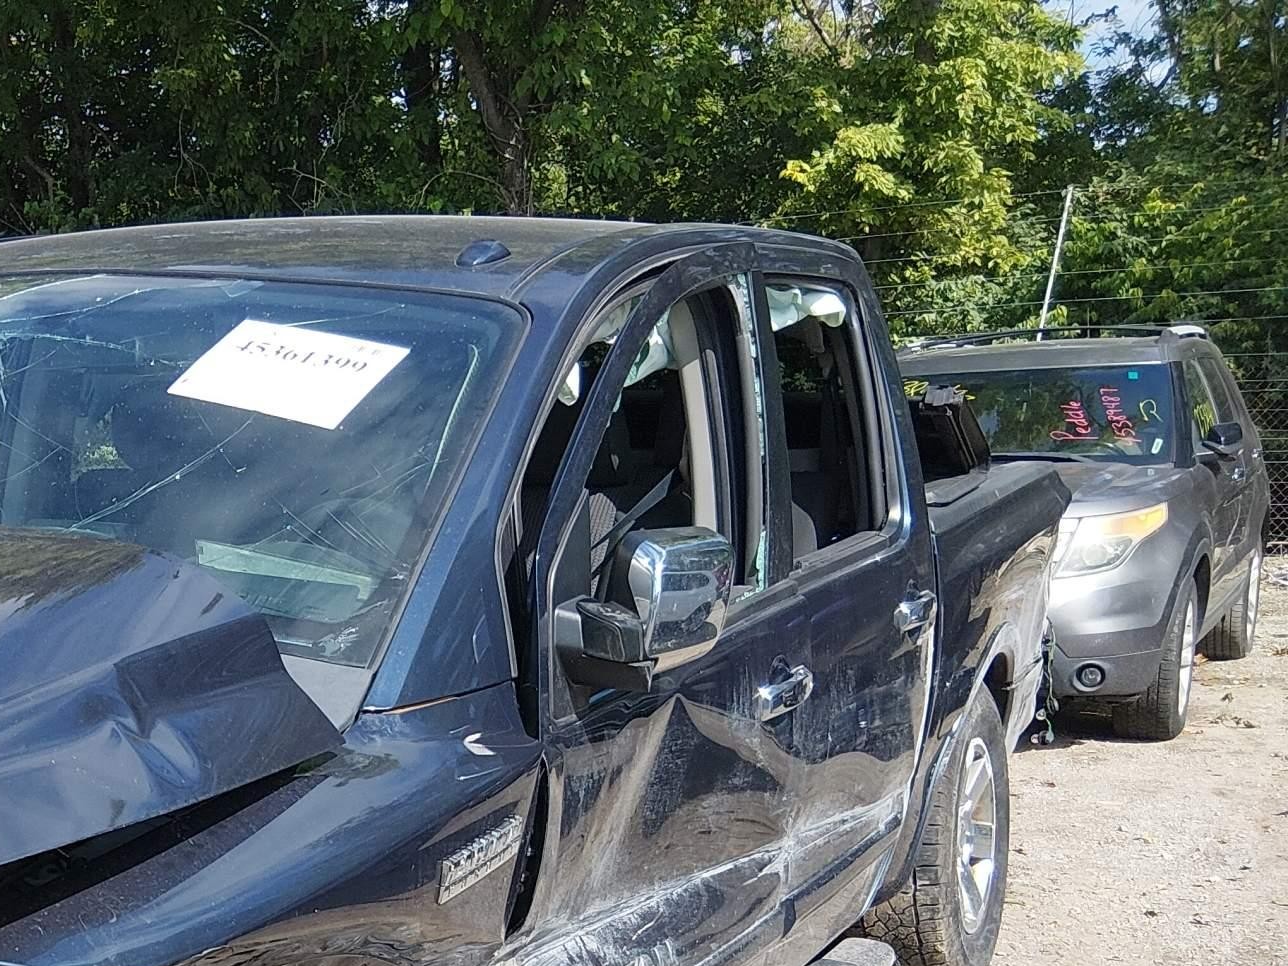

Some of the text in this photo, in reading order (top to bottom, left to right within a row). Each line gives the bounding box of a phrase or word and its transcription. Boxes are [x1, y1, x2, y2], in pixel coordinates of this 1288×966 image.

[235, 339, 368, 374] 45361399
[1049, 400, 1099, 441] Peddle
[1099, 387, 1143, 446] 45389487
